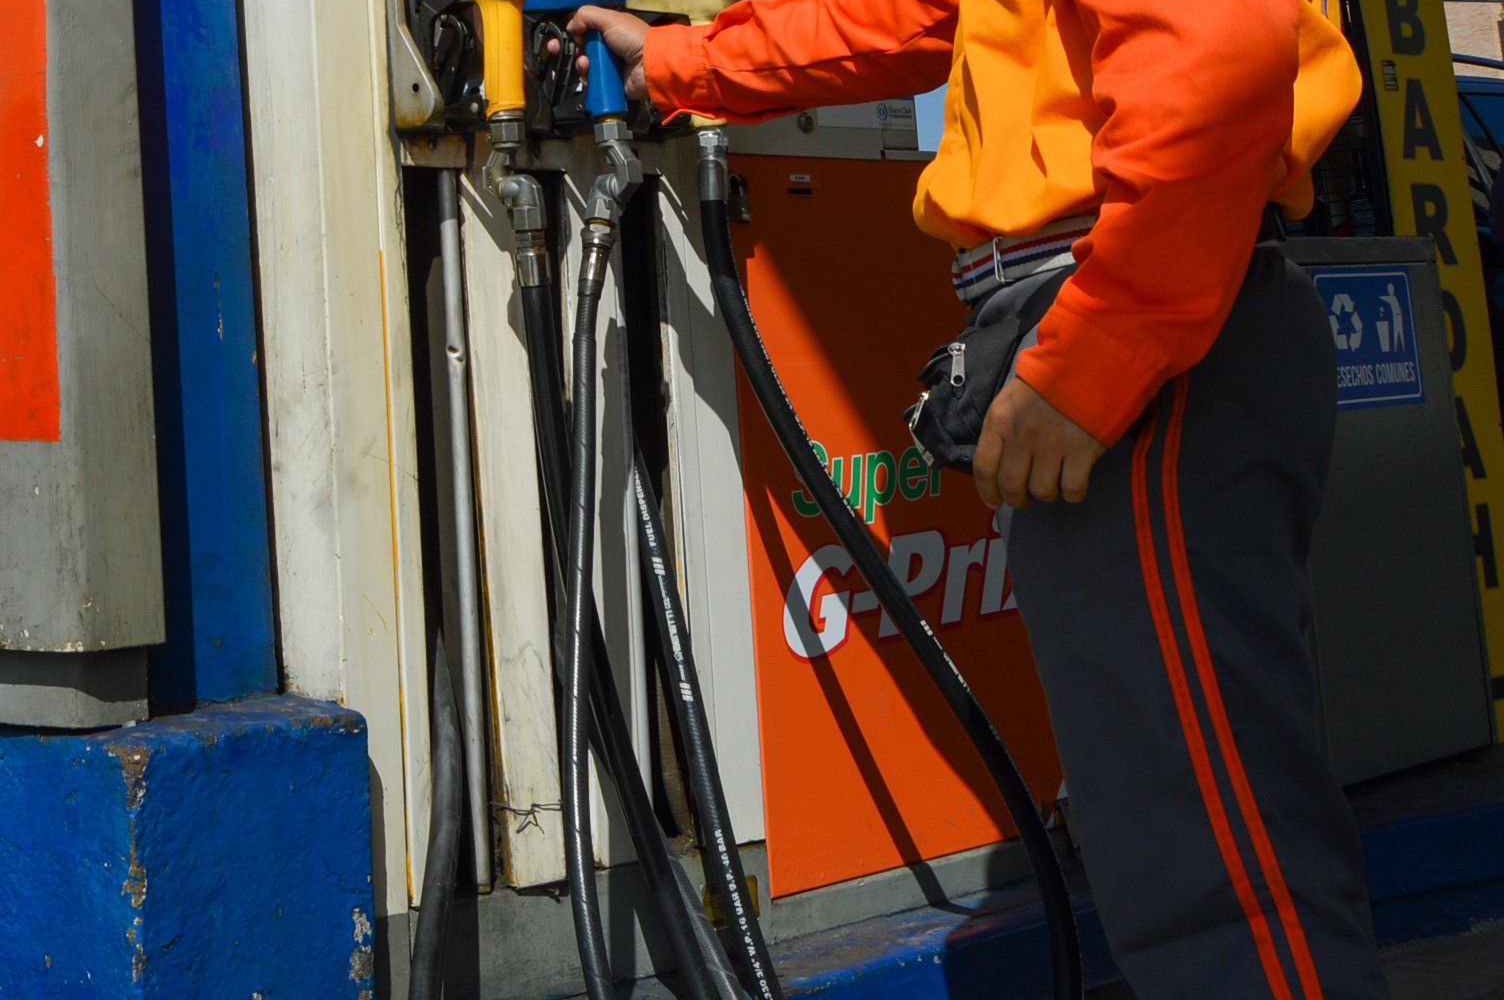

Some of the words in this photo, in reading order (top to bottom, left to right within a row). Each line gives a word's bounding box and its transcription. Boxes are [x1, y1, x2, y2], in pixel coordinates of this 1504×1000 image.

[1337, 365, 1374, 387] ESECHOS
[1376, 361, 1415, 385] COMUNES
[643, 521, 657, 547] FUEL
[783, 511, 1018, 660] G-Pri
[715, 828, 726, 852] BAR
[732, 891, 743, 915] BAR
